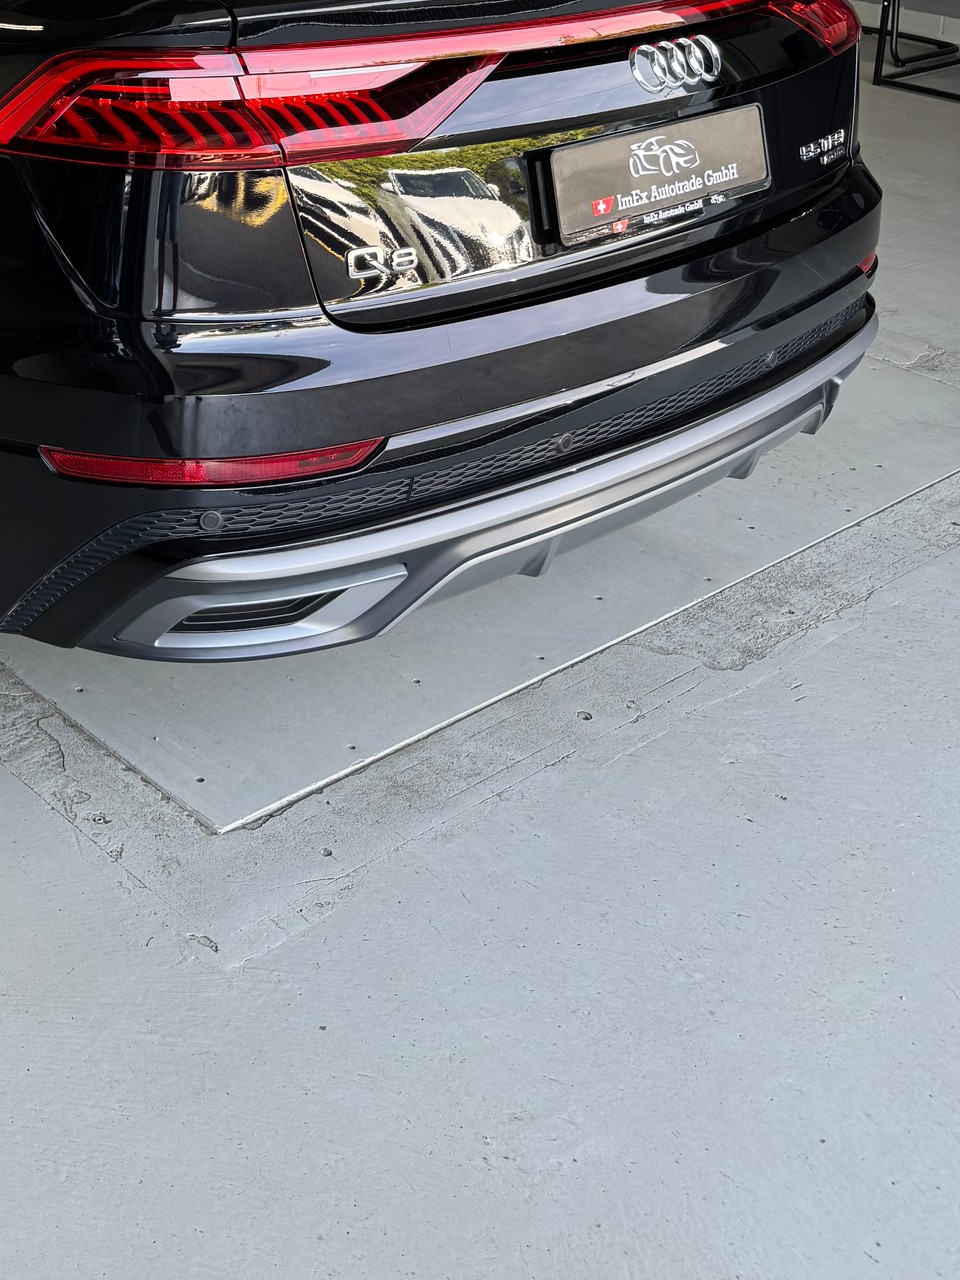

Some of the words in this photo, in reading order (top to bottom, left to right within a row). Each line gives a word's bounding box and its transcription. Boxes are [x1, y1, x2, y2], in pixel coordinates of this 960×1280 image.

[616, 189, 649, 211] ImEx
[650, 175, 703, 202] Autotrade
[704, 163, 739, 186] GmbH
[346, 246, 419, 279] Q8
